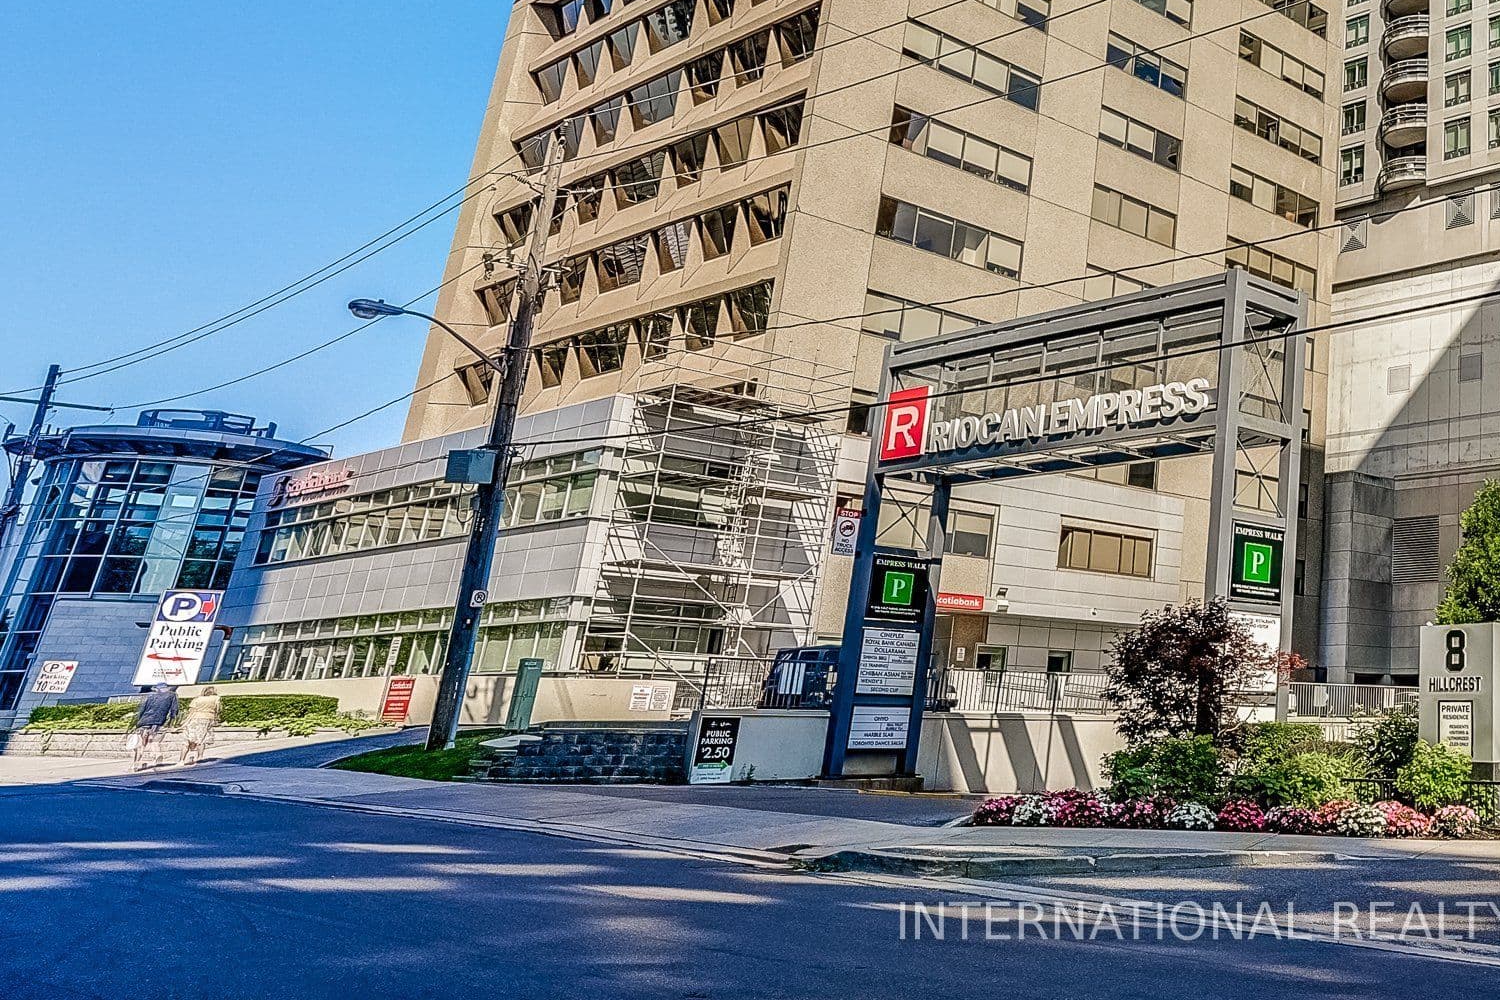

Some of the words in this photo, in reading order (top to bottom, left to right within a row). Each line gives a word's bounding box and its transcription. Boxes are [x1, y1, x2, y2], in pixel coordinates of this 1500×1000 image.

[929, 403, 1046, 452] RIOCAN
[1051, 378, 1210, 434] EMPRESS
[886, 407, 919, 451] R
[840, 510, 859, 518] STOP
[1235, 526, 1263, 538] EMPRESS
[1264, 532, 1283, 541] WALK
[876, 558, 906, 568] EMPRESS
[907, 561, 927, 570] WALK
[1251, 551, 1265, 575] P
[891, 578, 906, 598] P
[169, 597, 197, 616] P
[160, 625, 202, 637] Public
[149, 638, 204, 652] Parking
[1446, 629, 1465, 672] 8
[50, 663, 60, 672] P
[1429, 676, 1482, 693] HILLCREST
[1441, 705, 1470, 713] PRIVATE
[706, 730, 731, 738] PUBLIC
